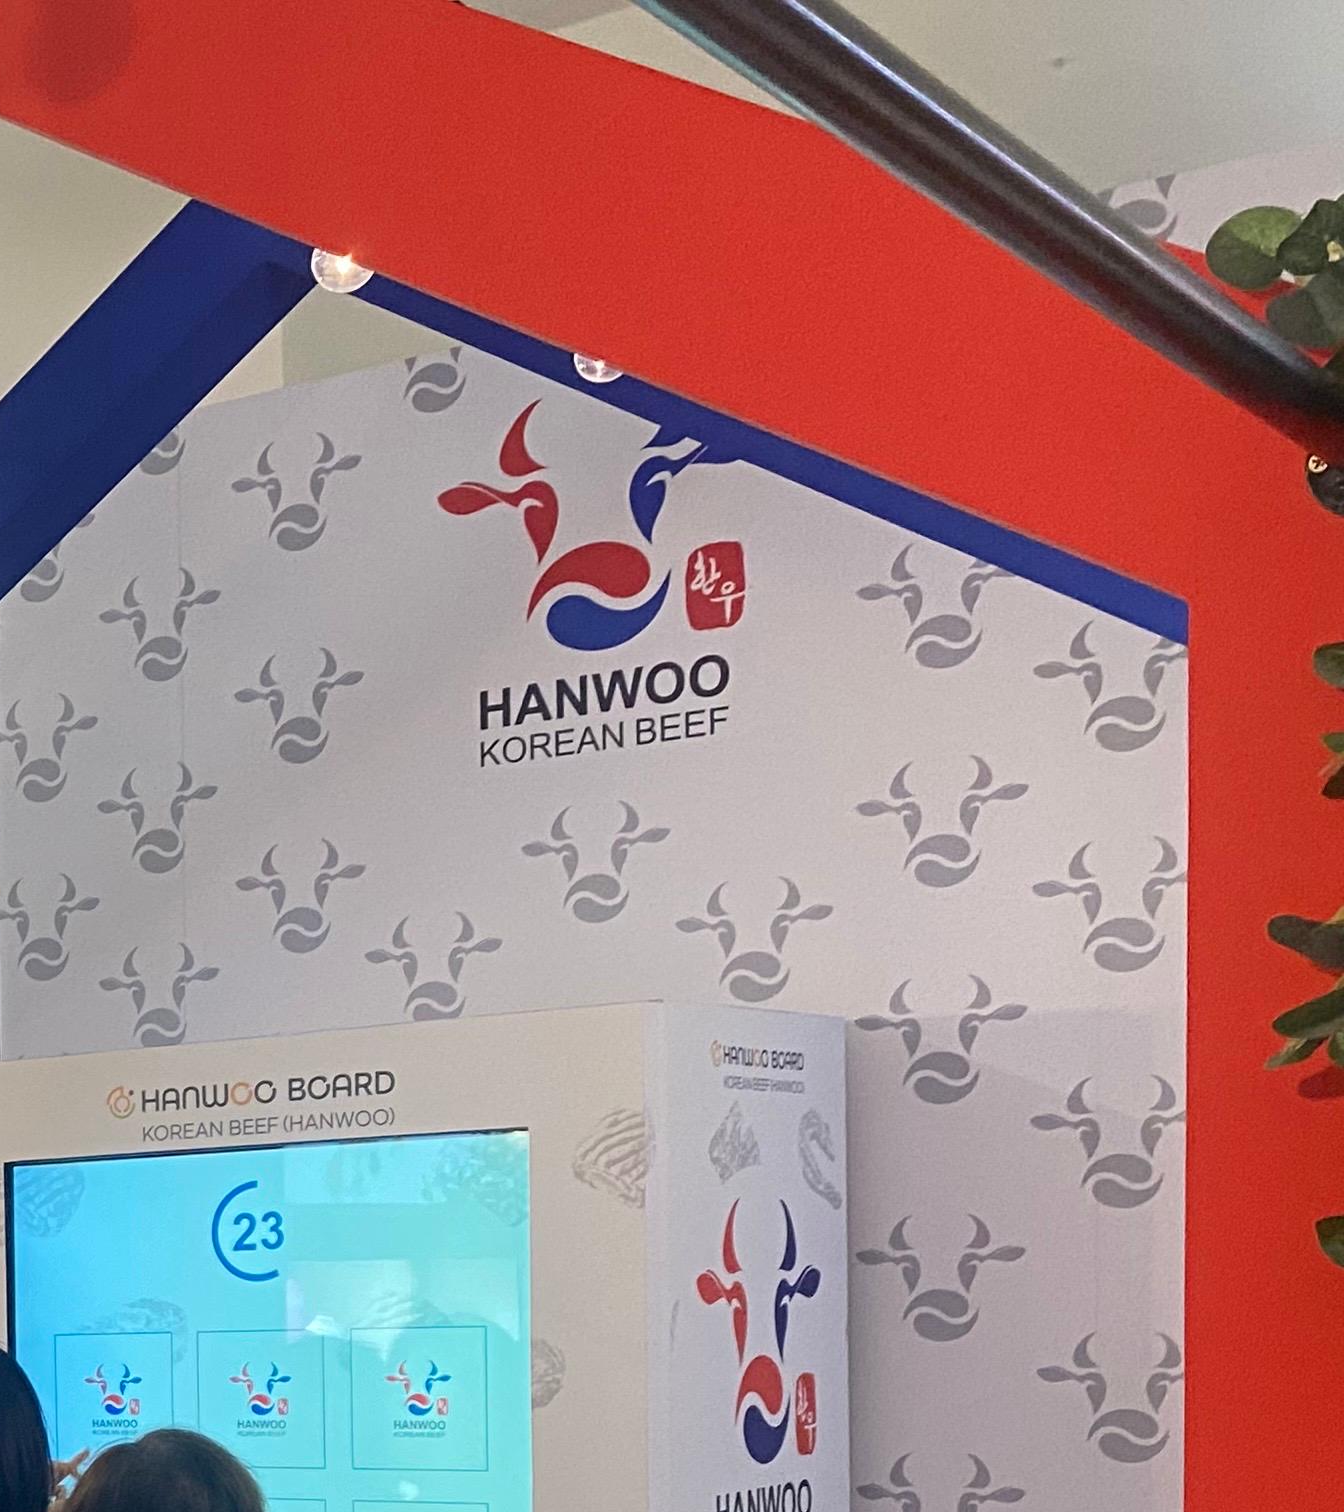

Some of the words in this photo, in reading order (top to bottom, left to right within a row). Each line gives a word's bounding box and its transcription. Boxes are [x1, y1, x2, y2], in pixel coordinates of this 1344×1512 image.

[479, 654, 731, 731] HANWOO
[480, 721, 625, 768] KOREAN
[635, 706, 730, 746] BEEF
[141, 1081, 277, 1113] HANWOO
[288, 1070, 397, 1102] BOARD
[141, 1121, 224, 1143] KOREAN
[229, 1116, 279, 1137] BEEF
[283, 1107, 397, 1133] (HANWOO)
[233, 1211, 286, 1252] 23
[91, 1418, 139, 1429] HANWOO
[237, 1419, 287, 1430] HANWOO
[393, 1420, 446, 1431] HANWOO
